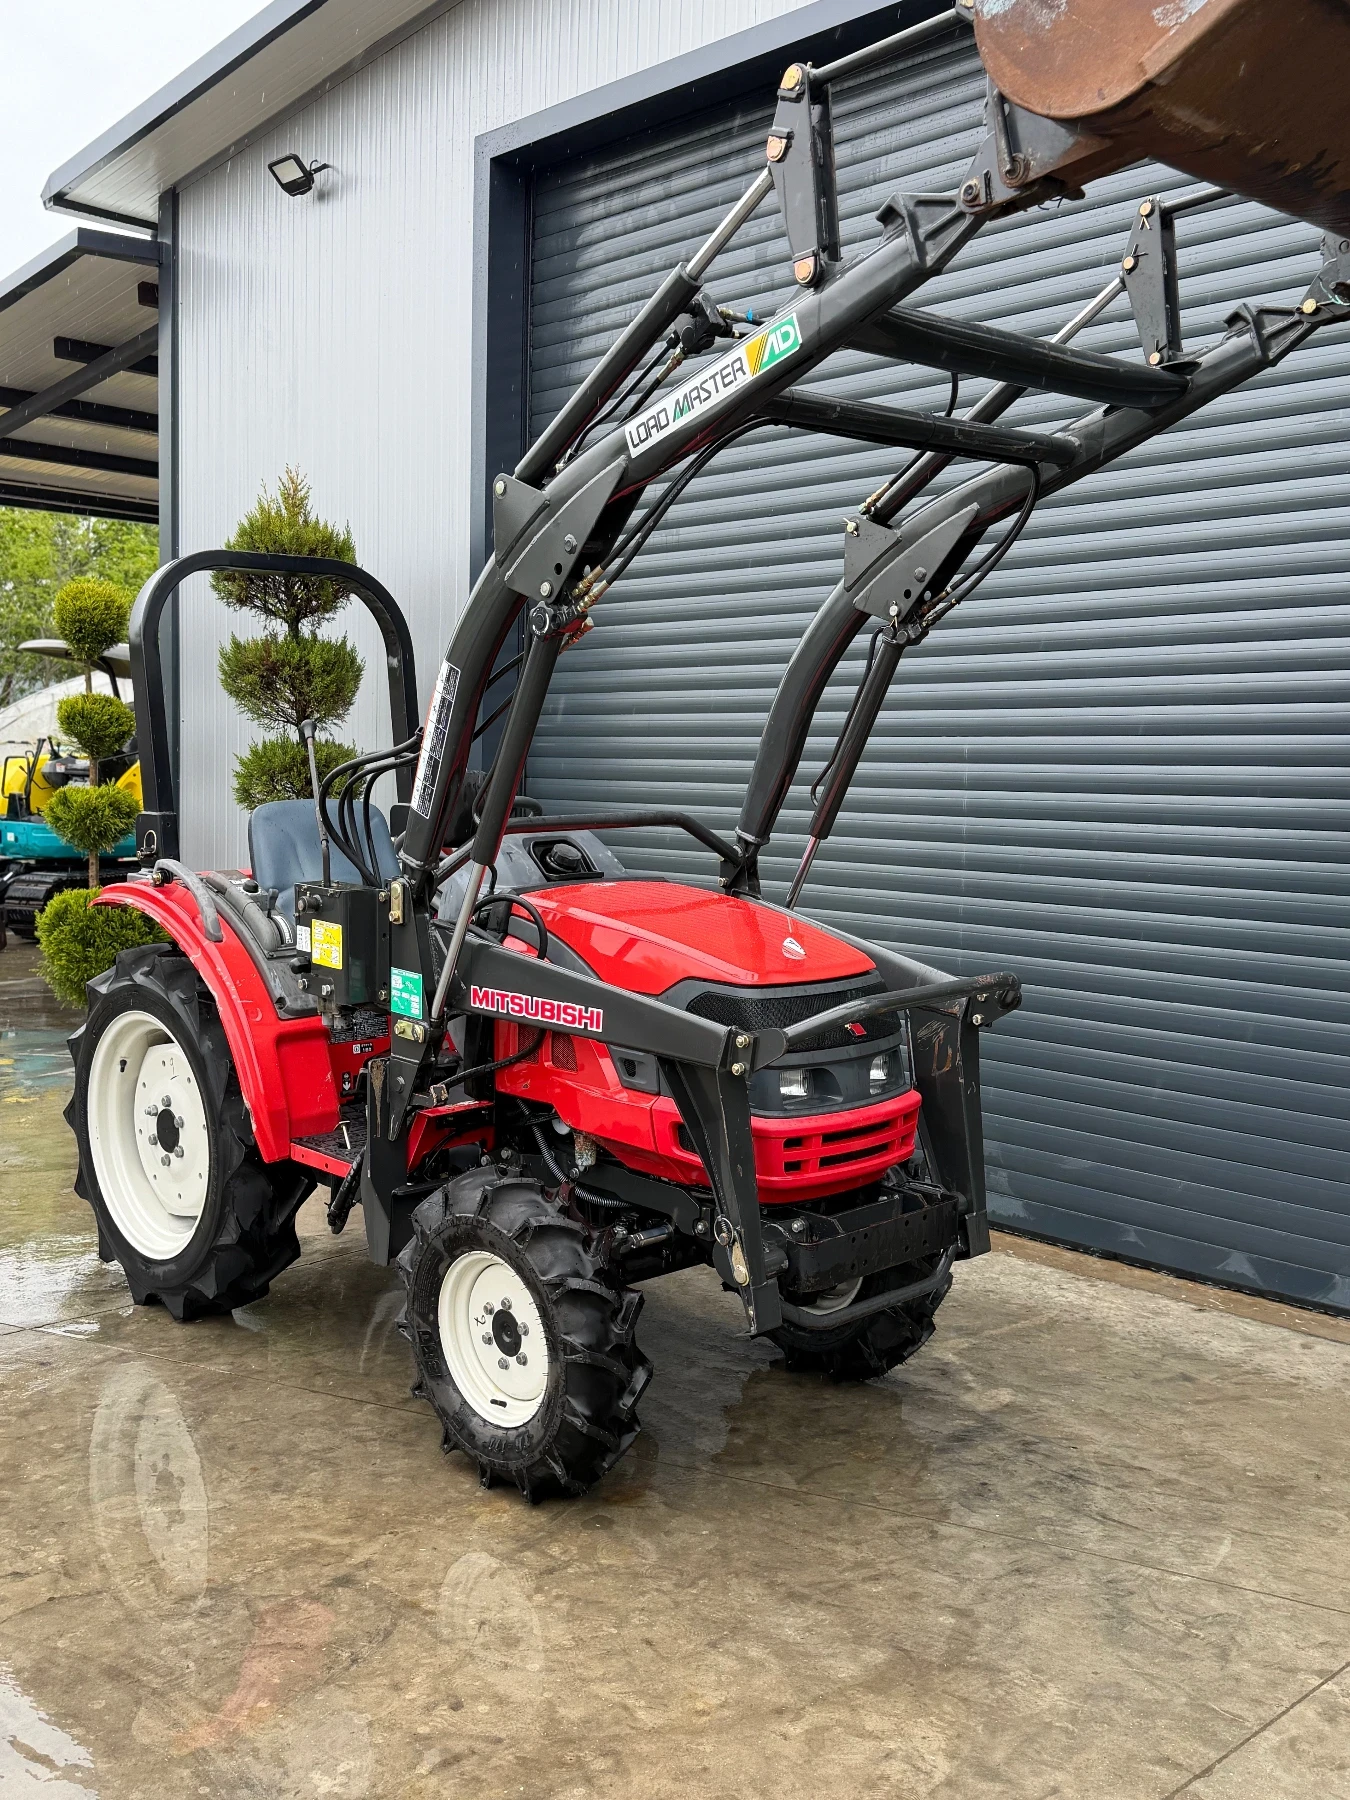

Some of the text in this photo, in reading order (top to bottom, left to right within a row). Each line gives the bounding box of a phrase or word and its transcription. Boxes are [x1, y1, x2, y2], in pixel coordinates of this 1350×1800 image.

[628, 407, 670, 449] LOAD
[672, 356, 747, 423] MASTER
[470, 985, 604, 1032] MITSUBISHI
